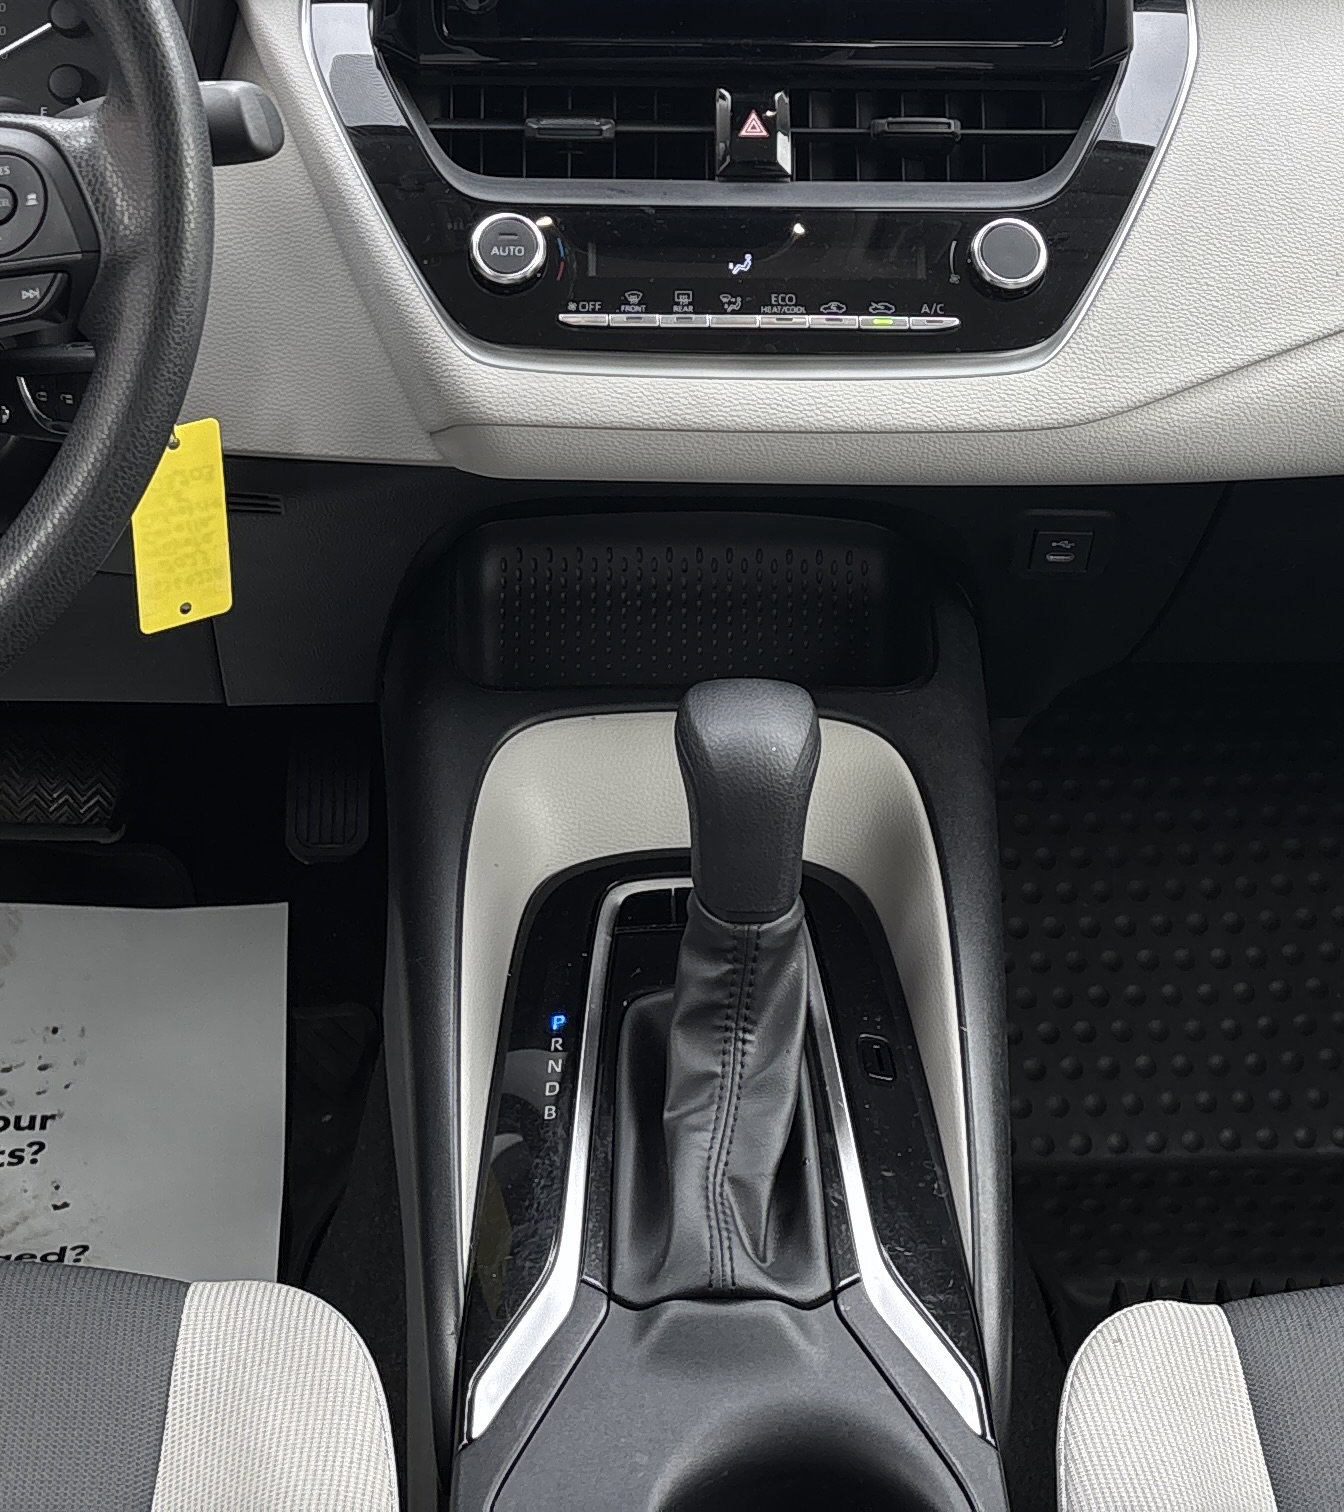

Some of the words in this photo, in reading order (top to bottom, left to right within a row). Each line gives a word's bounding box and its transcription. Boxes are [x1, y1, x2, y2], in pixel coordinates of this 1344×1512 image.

[490, 246, 525, 256] AUTO
[771, 294, 796, 305] ECO
[579, 302, 602, 312] OFF
[621, 305, 646, 313] FRONT
[673, 305, 694, 313] REAR
[761, 306, 806, 314] HEAT/COOL
[921, 304, 945, 315] A/C
[551, 1014, 566, 1031] P
[551, 1037, 563, 1051] R
[547, 1059, 563, 1073] N
[545, 1081, 560, 1097] D
[544, 1105, 557, 1120] B
